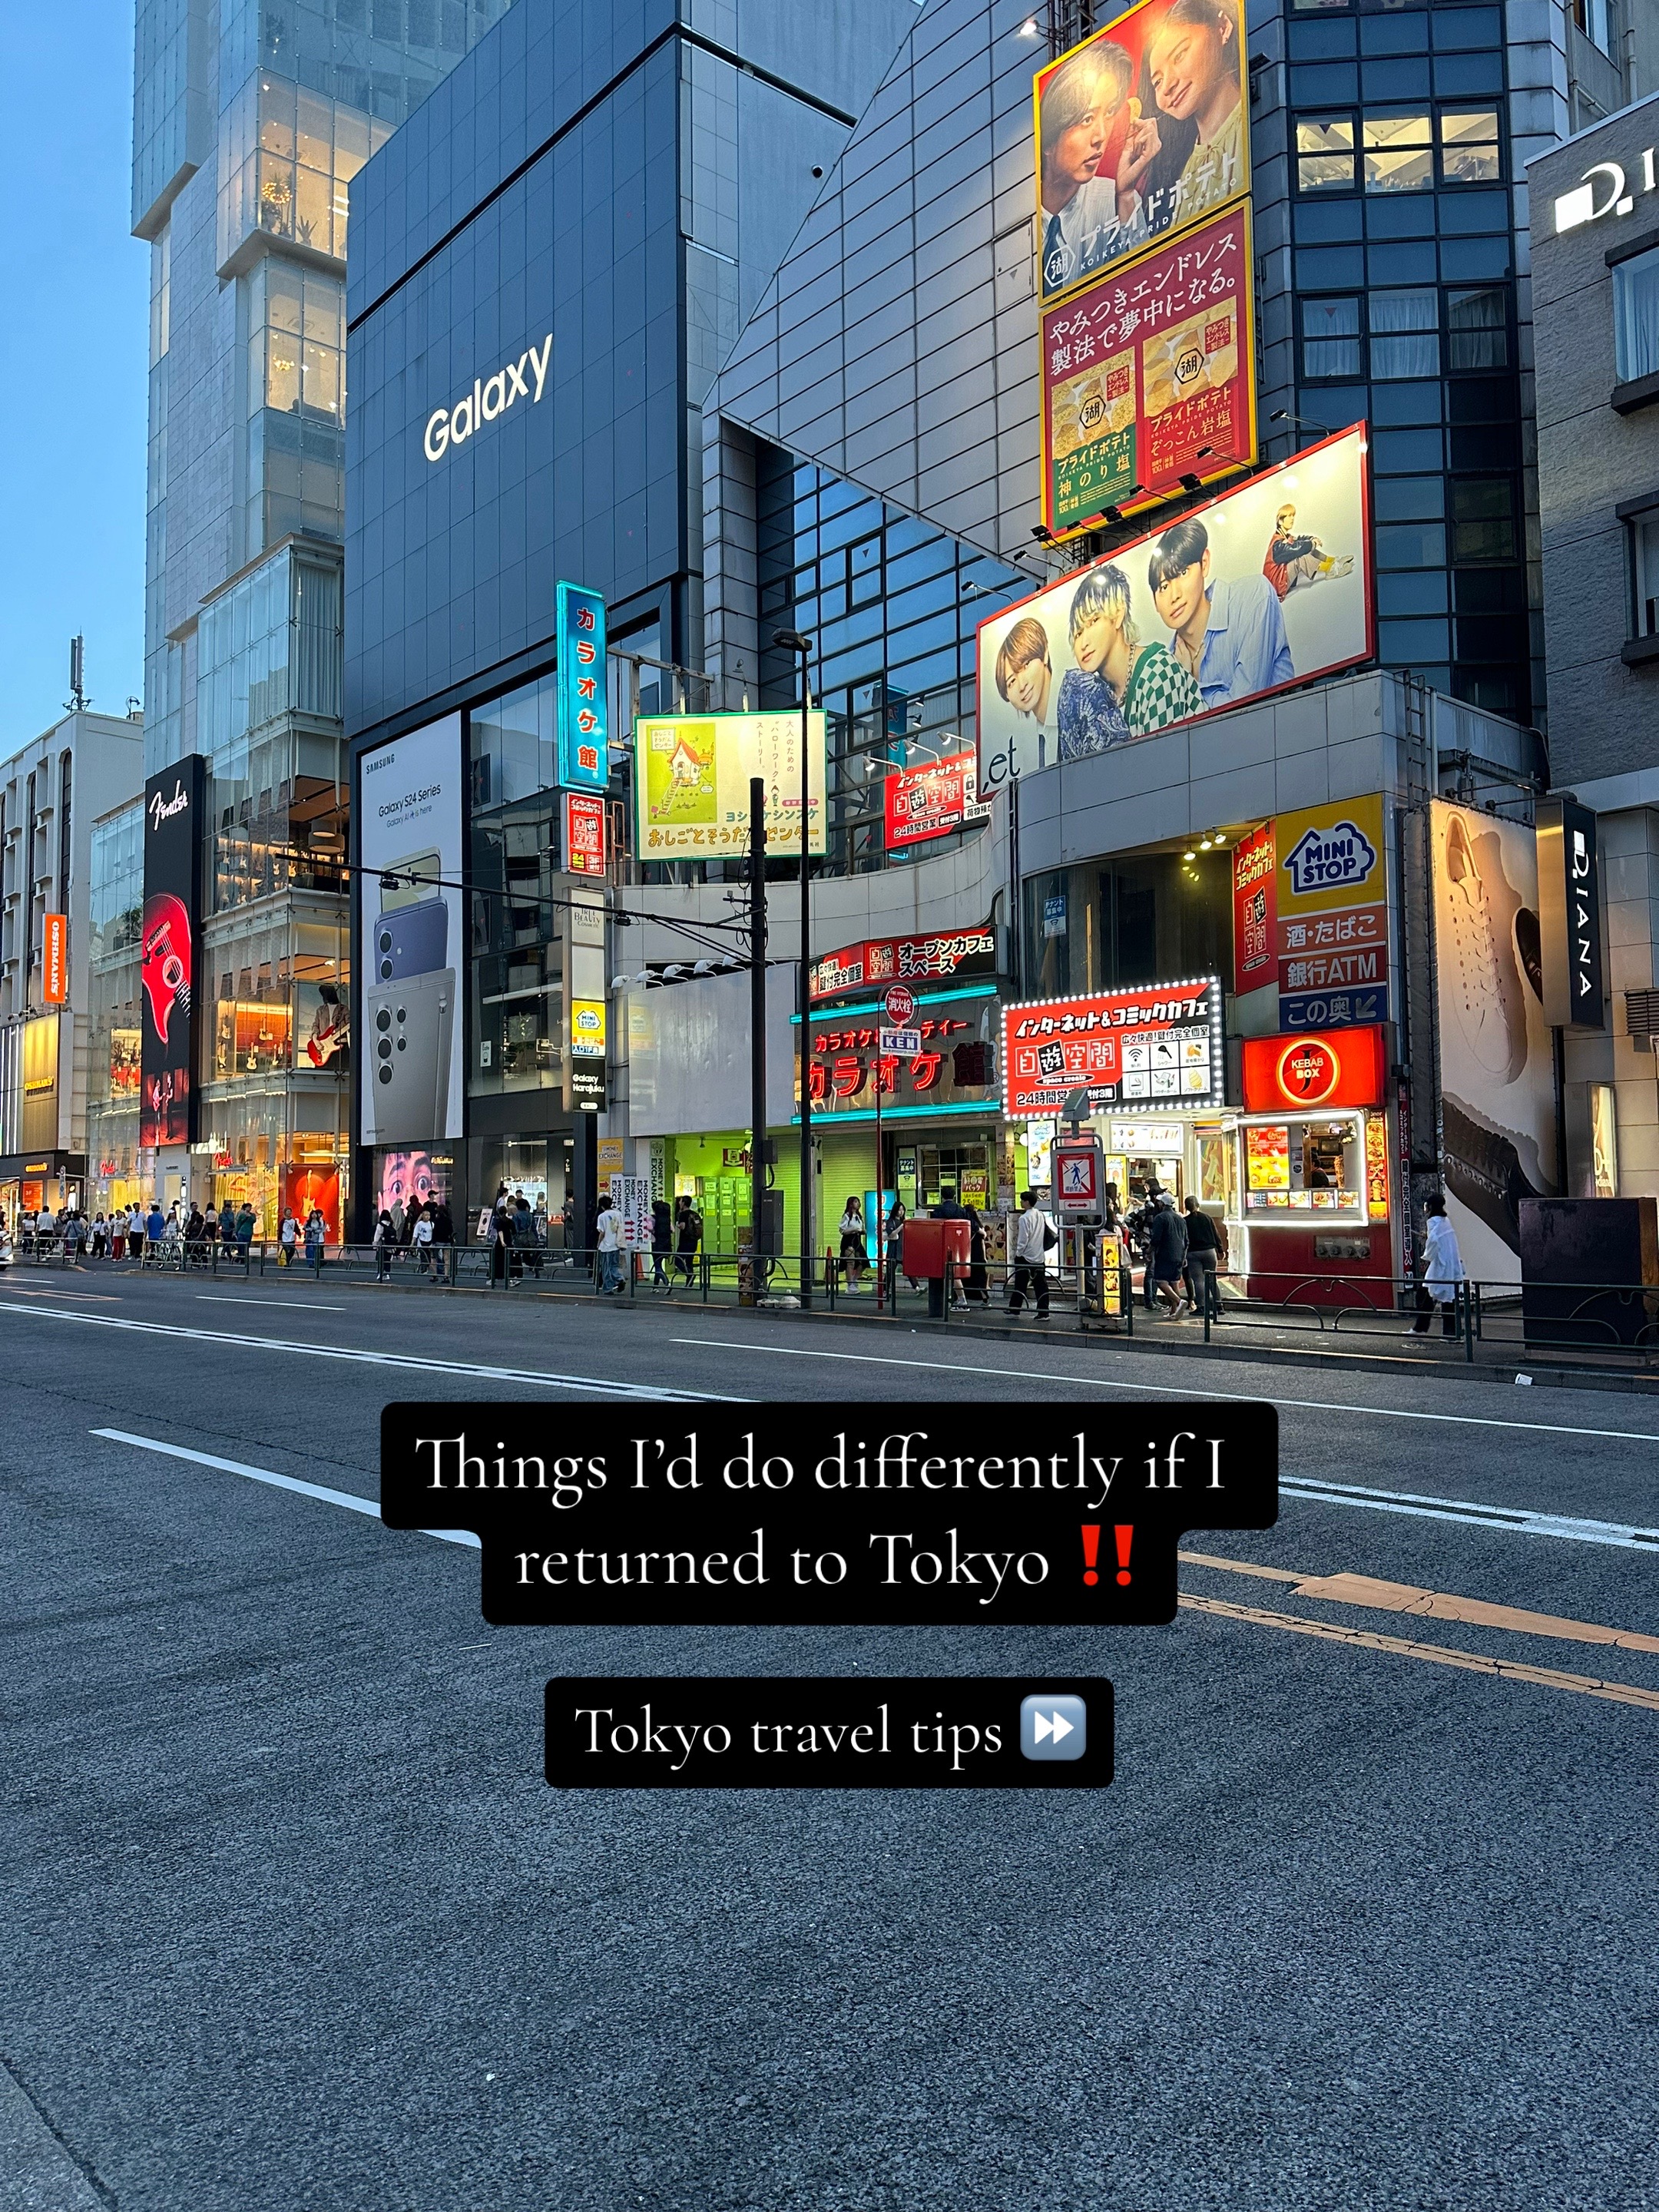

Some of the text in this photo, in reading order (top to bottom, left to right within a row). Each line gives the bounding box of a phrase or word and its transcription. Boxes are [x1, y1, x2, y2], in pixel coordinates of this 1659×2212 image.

[1080, 153, 1236, 257] プライドポテト
[1081, 177, 1237, 270] KOIKEYA PRIDE POTATO
[1050, 233, 1237, 344] やみつきエンドレス
[1051, 274, 1236, 376] 製法で夢中になる。
[424, 333, 553, 462] Galaxy
[1151, 387, 1231, 432] プライドポテト
[1151, 409, 1232, 456] ぞっこん岩塩
[1058, 432, 1130, 474] プライドポテト
[1058, 454, 1131, 498] 神のり塩
[577, 607, 598, 770] カラオケ館
[366, 753, 395, 775] SAMSUNG
[786, 720, 794, 773] 大人のための
[149, 780, 188, 831] Fender
[379, 784, 442, 817] Galaxy S24 Series
[895, 777, 960, 816] 自遊空間
[386, 814, 404, 828] Galaxy
[894, 819, 937, 839] 24時間営業
[1306, 838, 1353, 864] MINI
[1303, 857, 1356, 884] STOP
[898, 935, 994, 960] オープンカフェ
[898, 955, 955, 978] スペース
[1287, 952, 1376, 988] 銀行ATM
[889, 997, 911, 1013] 消火栓
[1015, 998, 1209, 1038] インターネット&コミックカフェ
[1288, 995, 1352, 1025] この奥
[886, 1036, 915, 1049] KEN
[1018, 1040, 1114, 1075] 自遊空間
[572, 1074, 598, 1085] Galaxy
[1292, 1058, 1324, 1069] KEBAB
[1296, 1068, 1320, 1079] BOX
[572, 1084, 604, 1094] Harajuku
